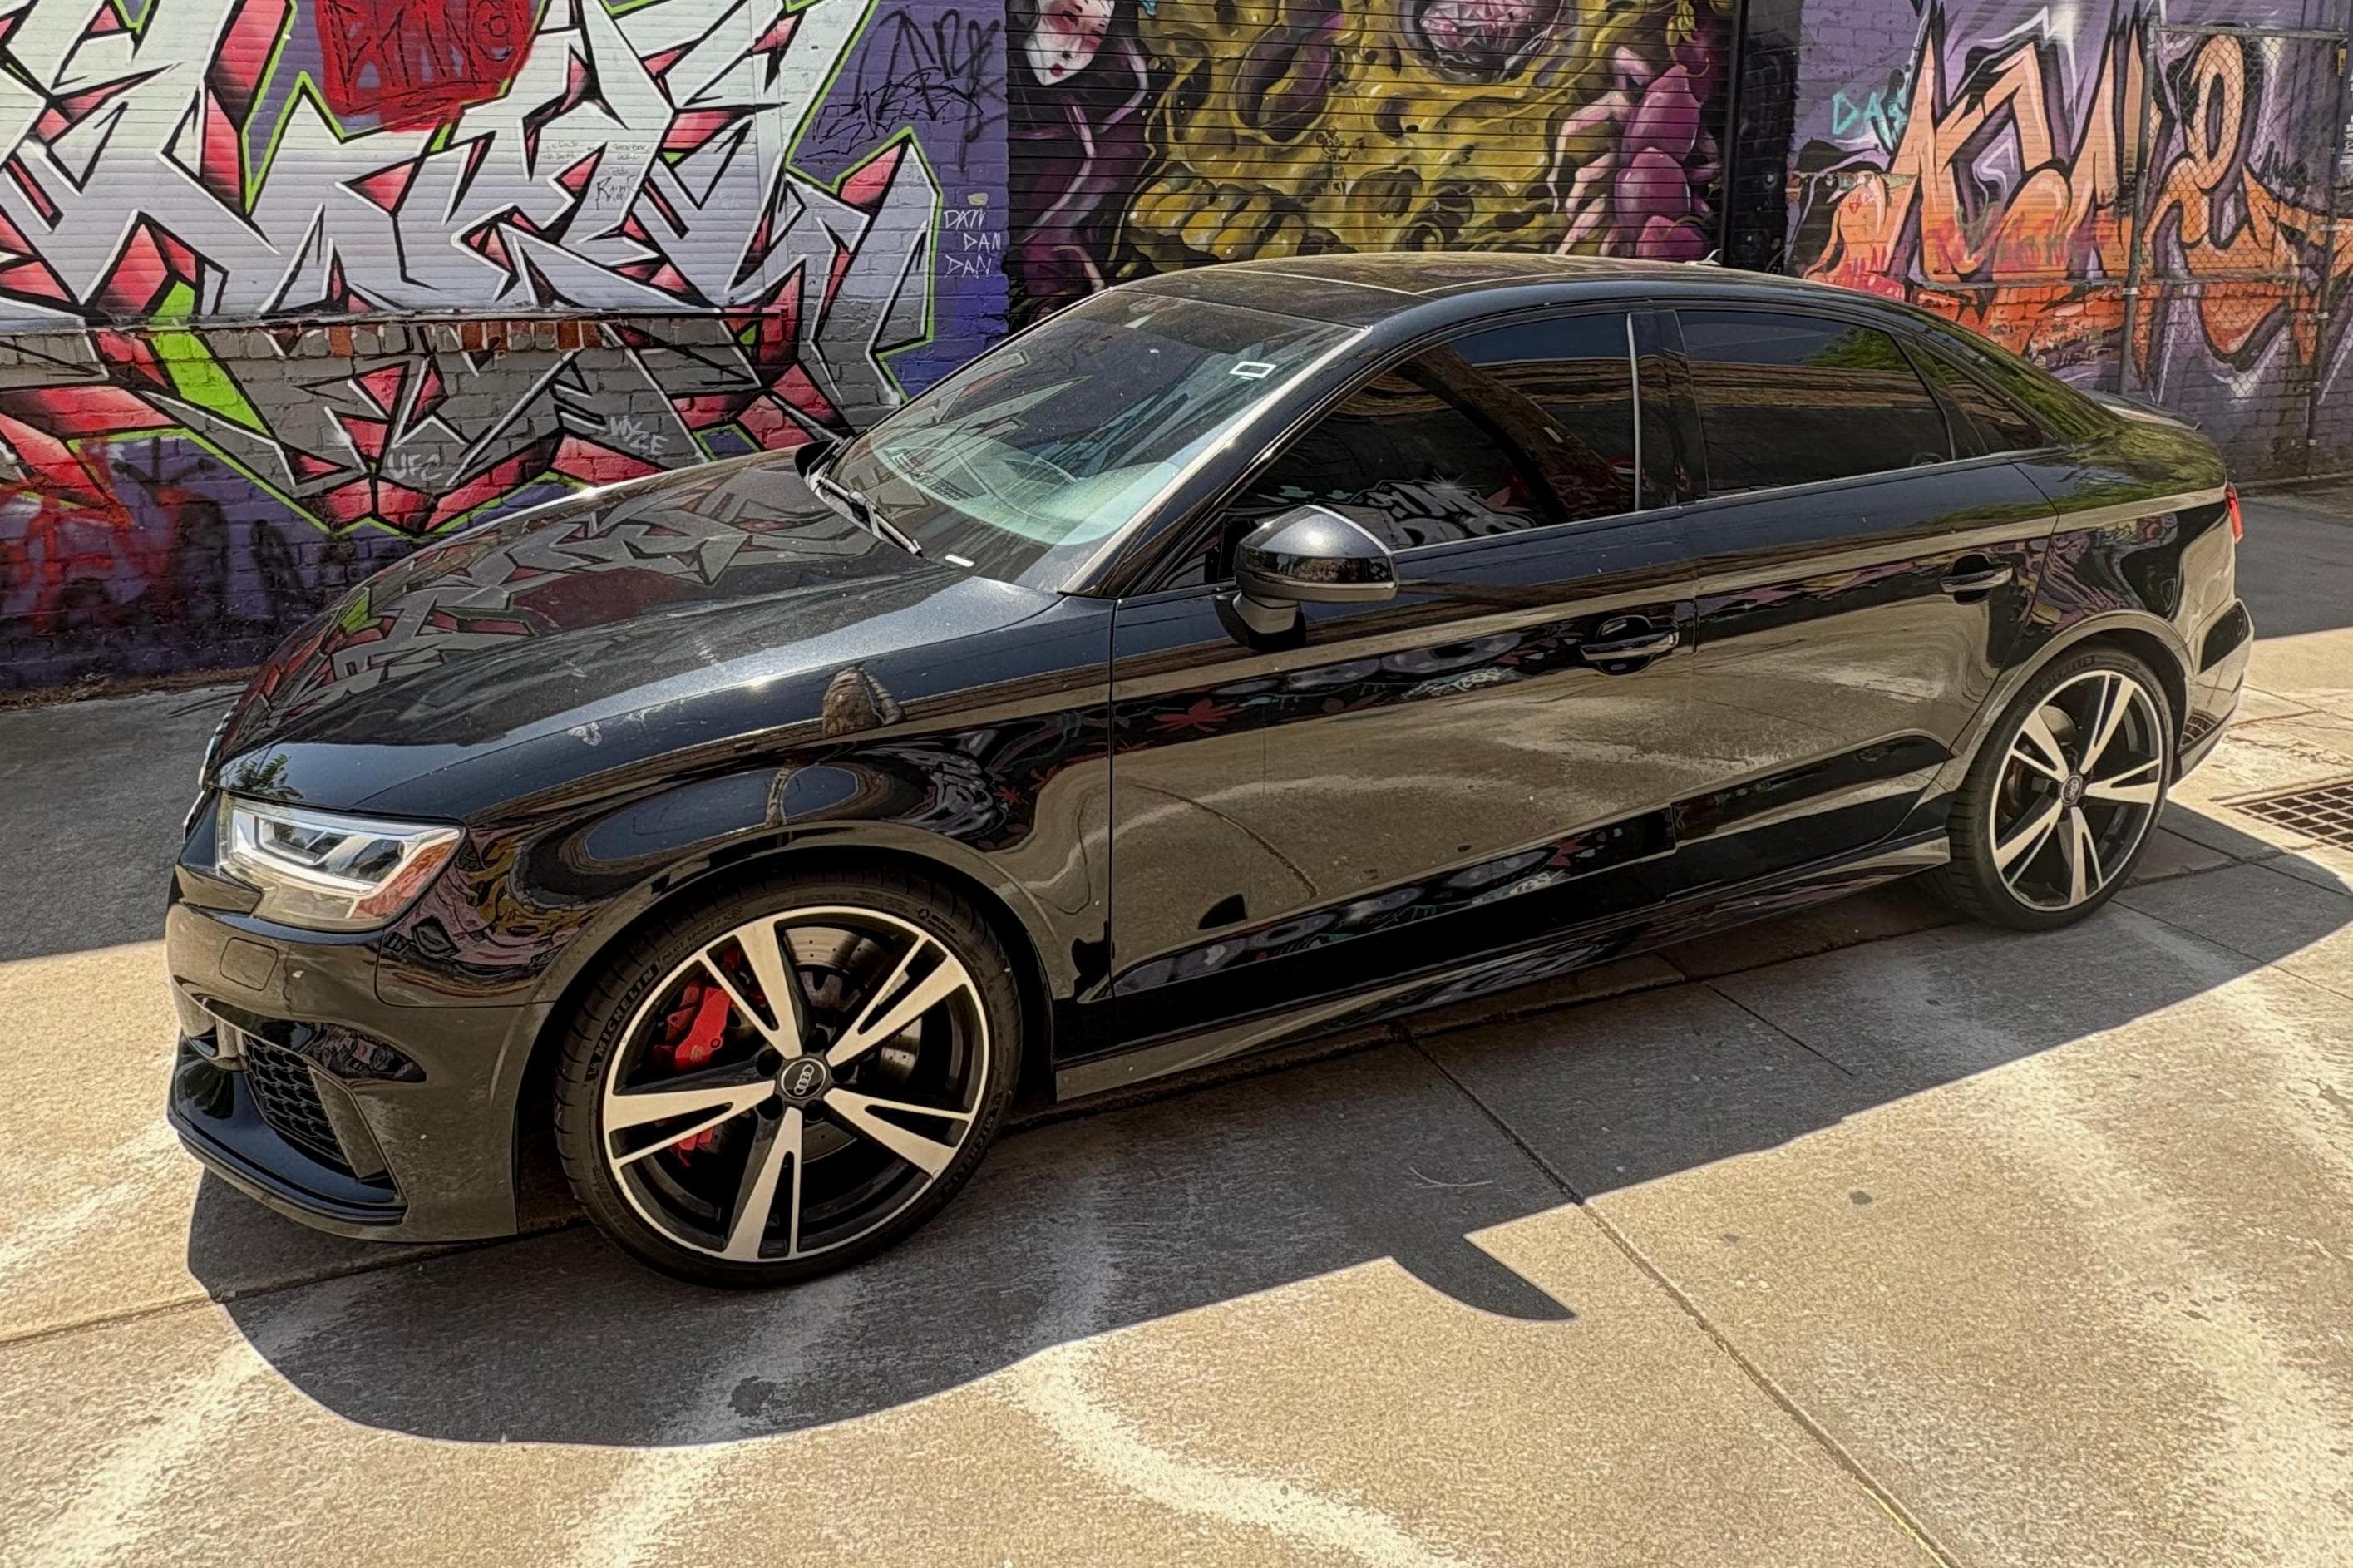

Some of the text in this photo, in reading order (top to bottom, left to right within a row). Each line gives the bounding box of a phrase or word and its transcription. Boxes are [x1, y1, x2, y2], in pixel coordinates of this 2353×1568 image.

[964, 232, 1001, 254] DAN
[387, 453, 442, 481] UFC
[594, 968, 656, 1058] MICHELIN
